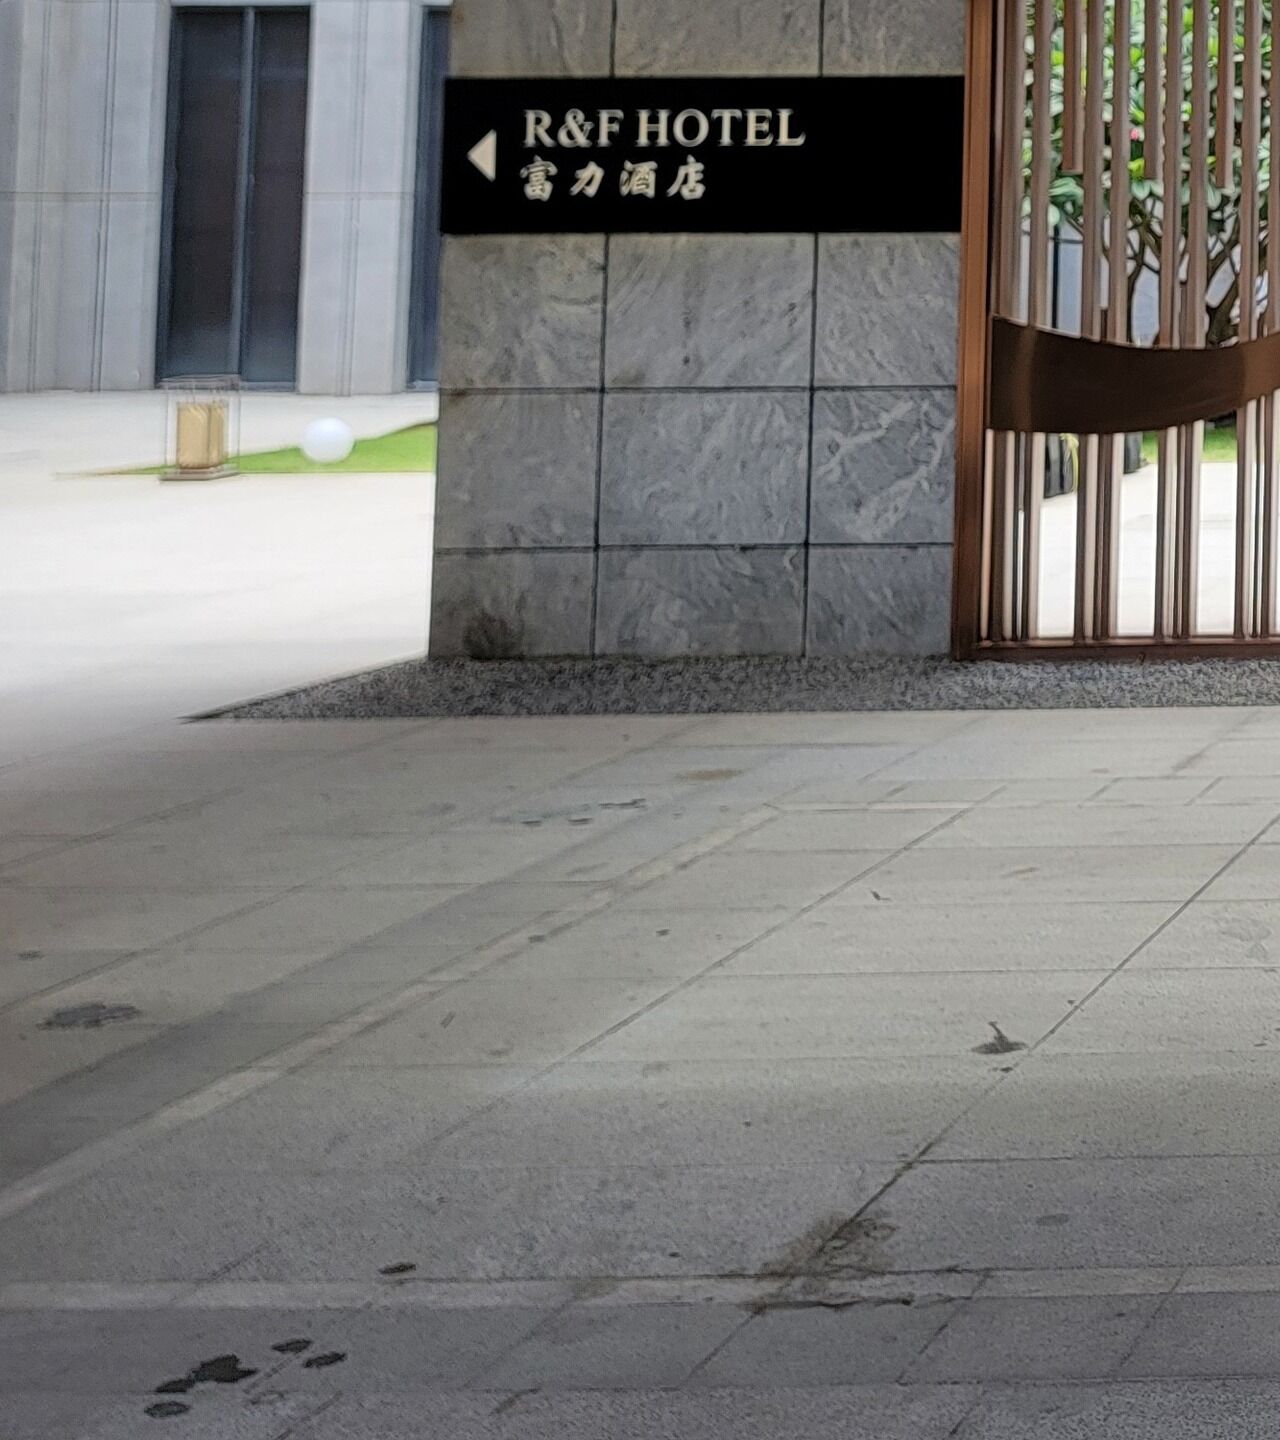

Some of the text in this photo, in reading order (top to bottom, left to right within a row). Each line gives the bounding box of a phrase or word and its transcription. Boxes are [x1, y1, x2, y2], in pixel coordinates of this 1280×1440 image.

[523, 108, 806, 148] R&F HOTEL
[520, 155, 706, 201] 富力酒店
